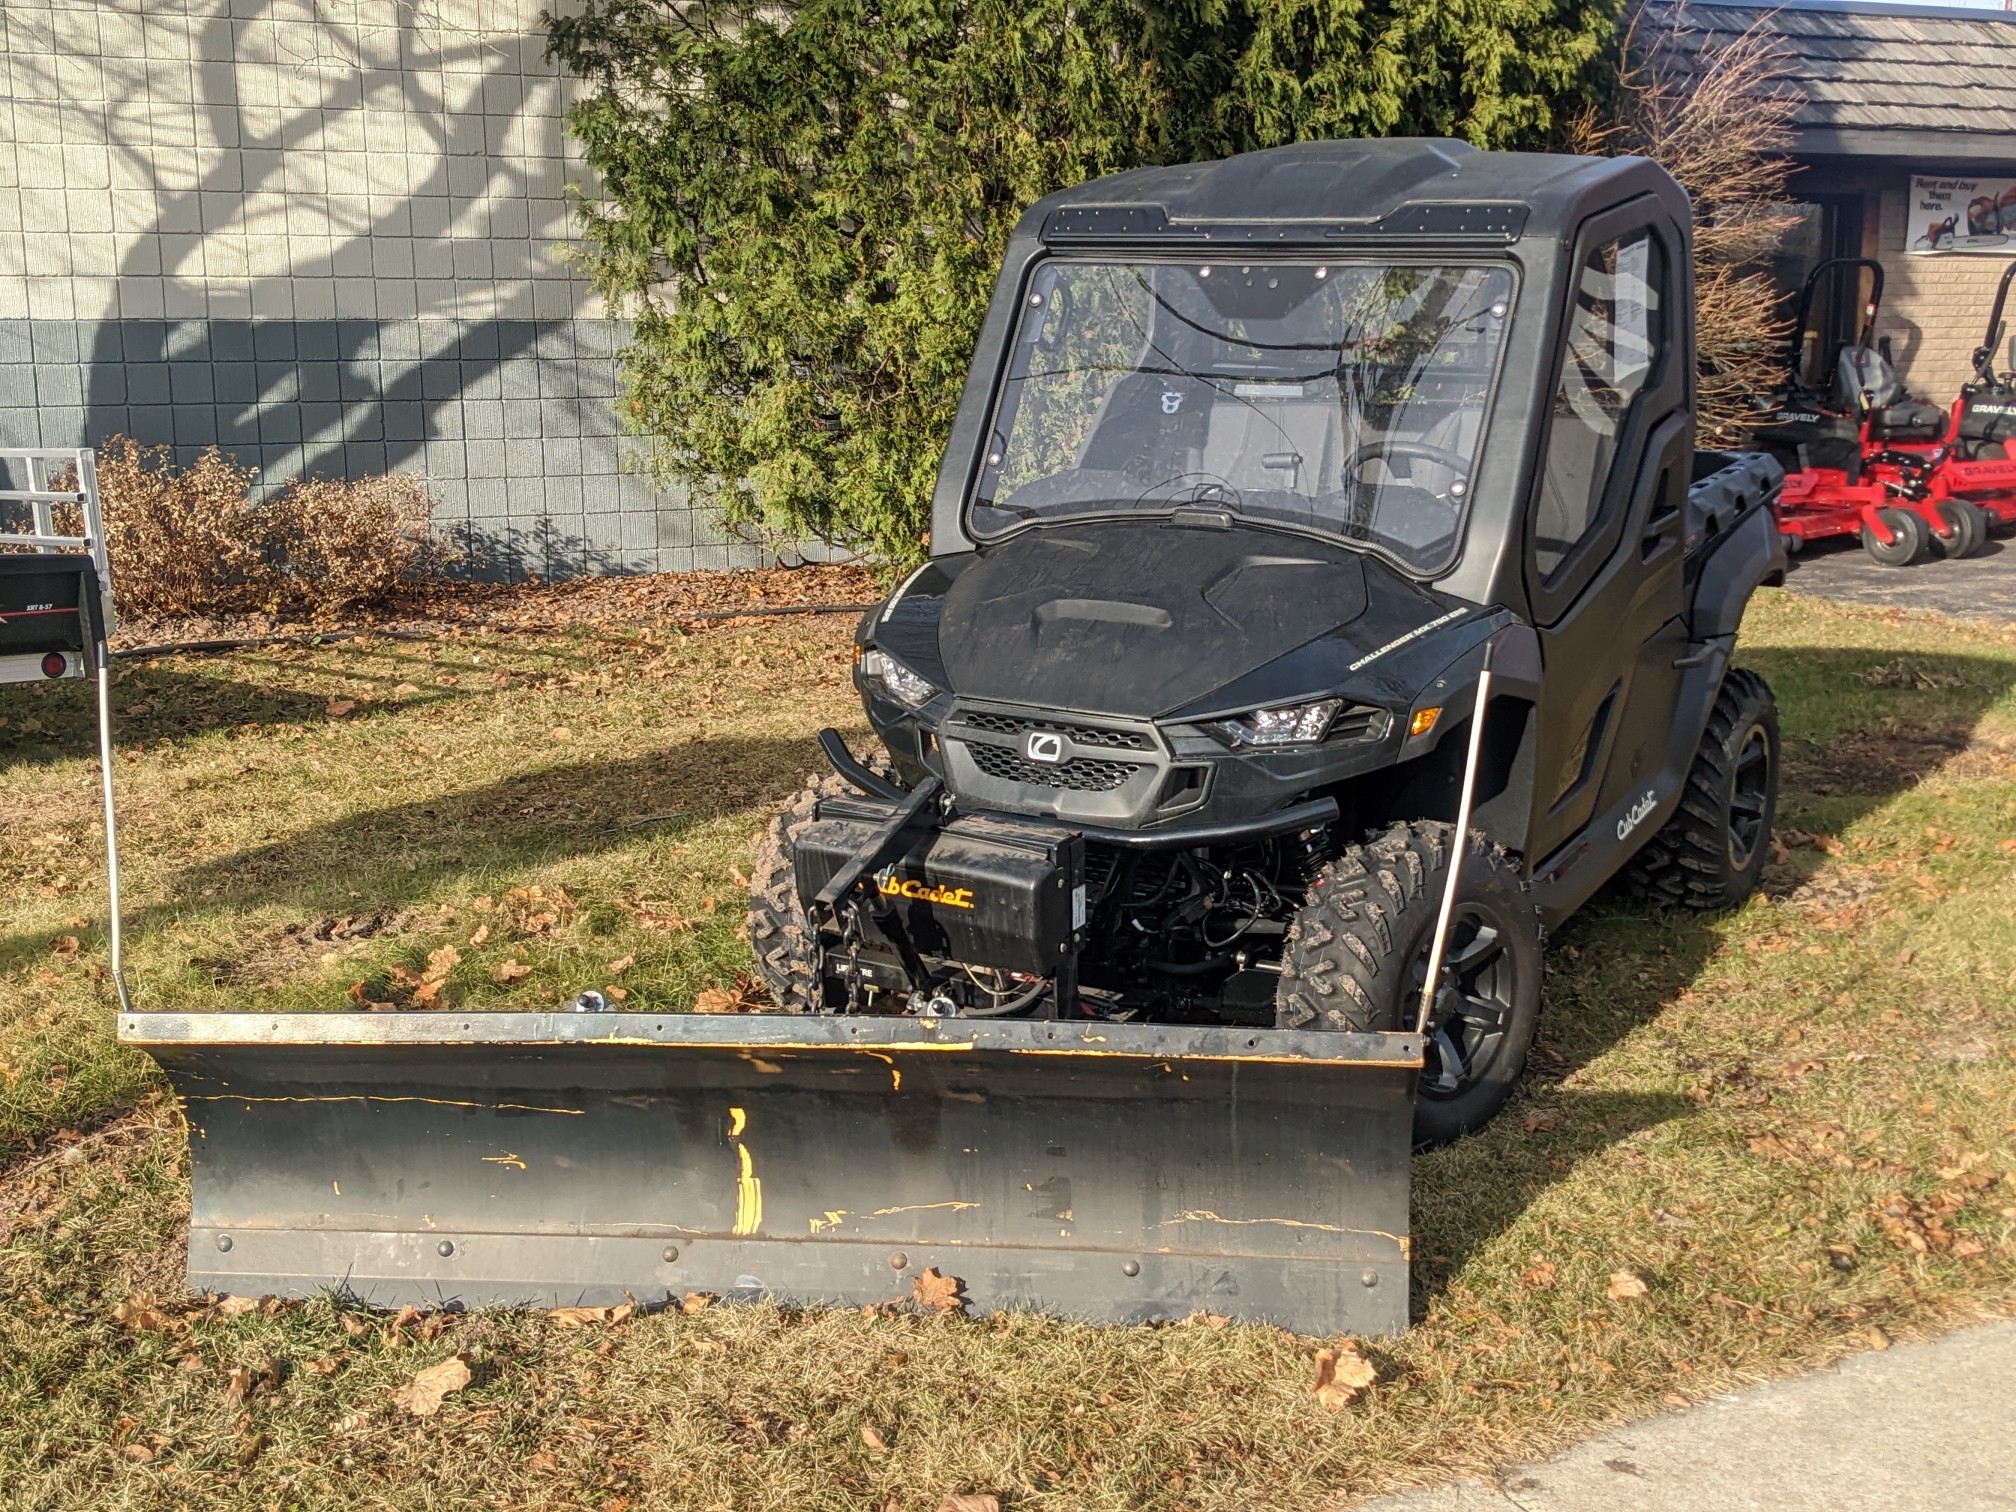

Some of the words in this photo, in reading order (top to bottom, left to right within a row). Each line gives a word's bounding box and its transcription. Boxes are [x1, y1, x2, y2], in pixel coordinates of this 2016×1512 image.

[1916, 178, 1938, 189] Rent
[1939, 180, 1958, 190] and
[1958, 181, 1978, 192] buy
[1929, 190, 1951, 200] them
[1920, 200, 1943, 210] here.
[1776, 412, 1820, 423] GRAVELY
[1349, 631, 1415, 671] CHALLENGER
[1413, 623, 1432, 636] MX
[1617, 813, 1633, 840] Cub
[1631, 790, 1657, 824] Cadet
